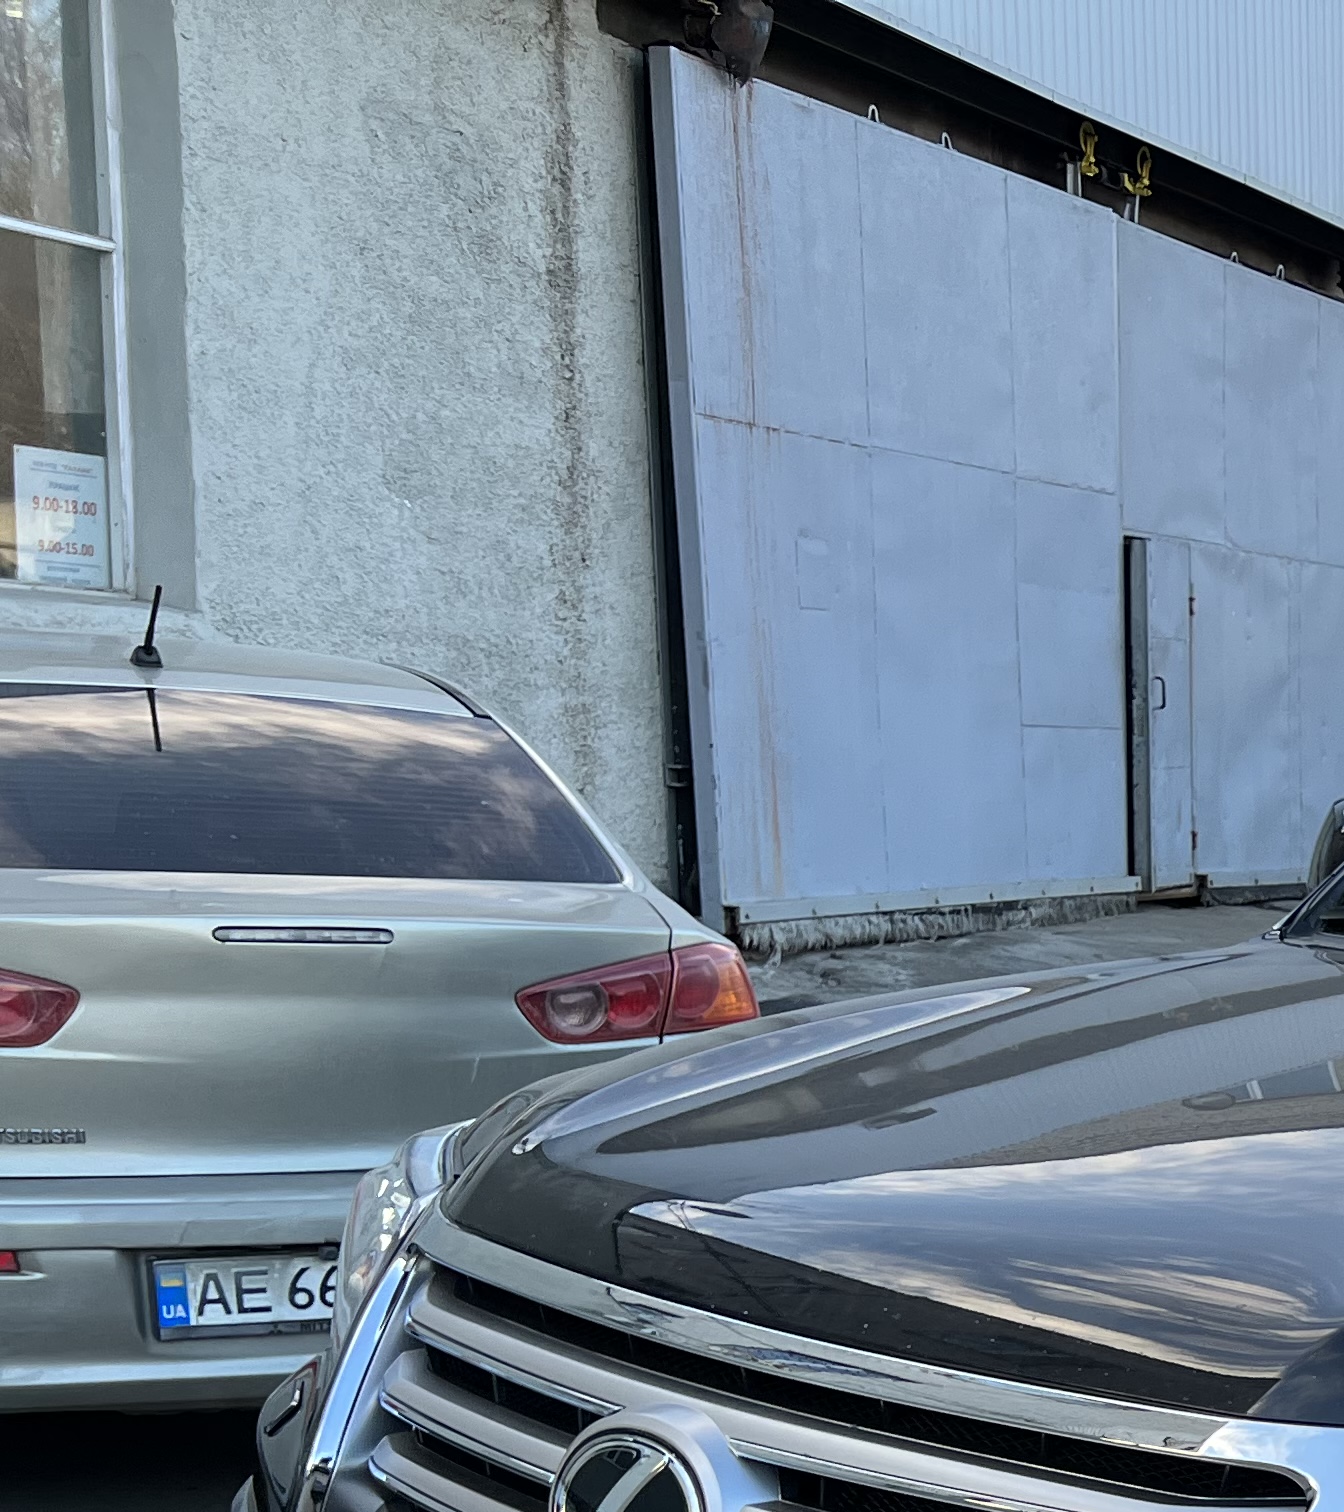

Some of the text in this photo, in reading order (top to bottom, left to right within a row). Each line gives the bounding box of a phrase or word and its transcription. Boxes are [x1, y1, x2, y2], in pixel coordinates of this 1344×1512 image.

[32, 495, 97, 516] 9.00-18.00
[198, 1272, 272, 1317] AE
[162, 1304, 187, 1319] UA
